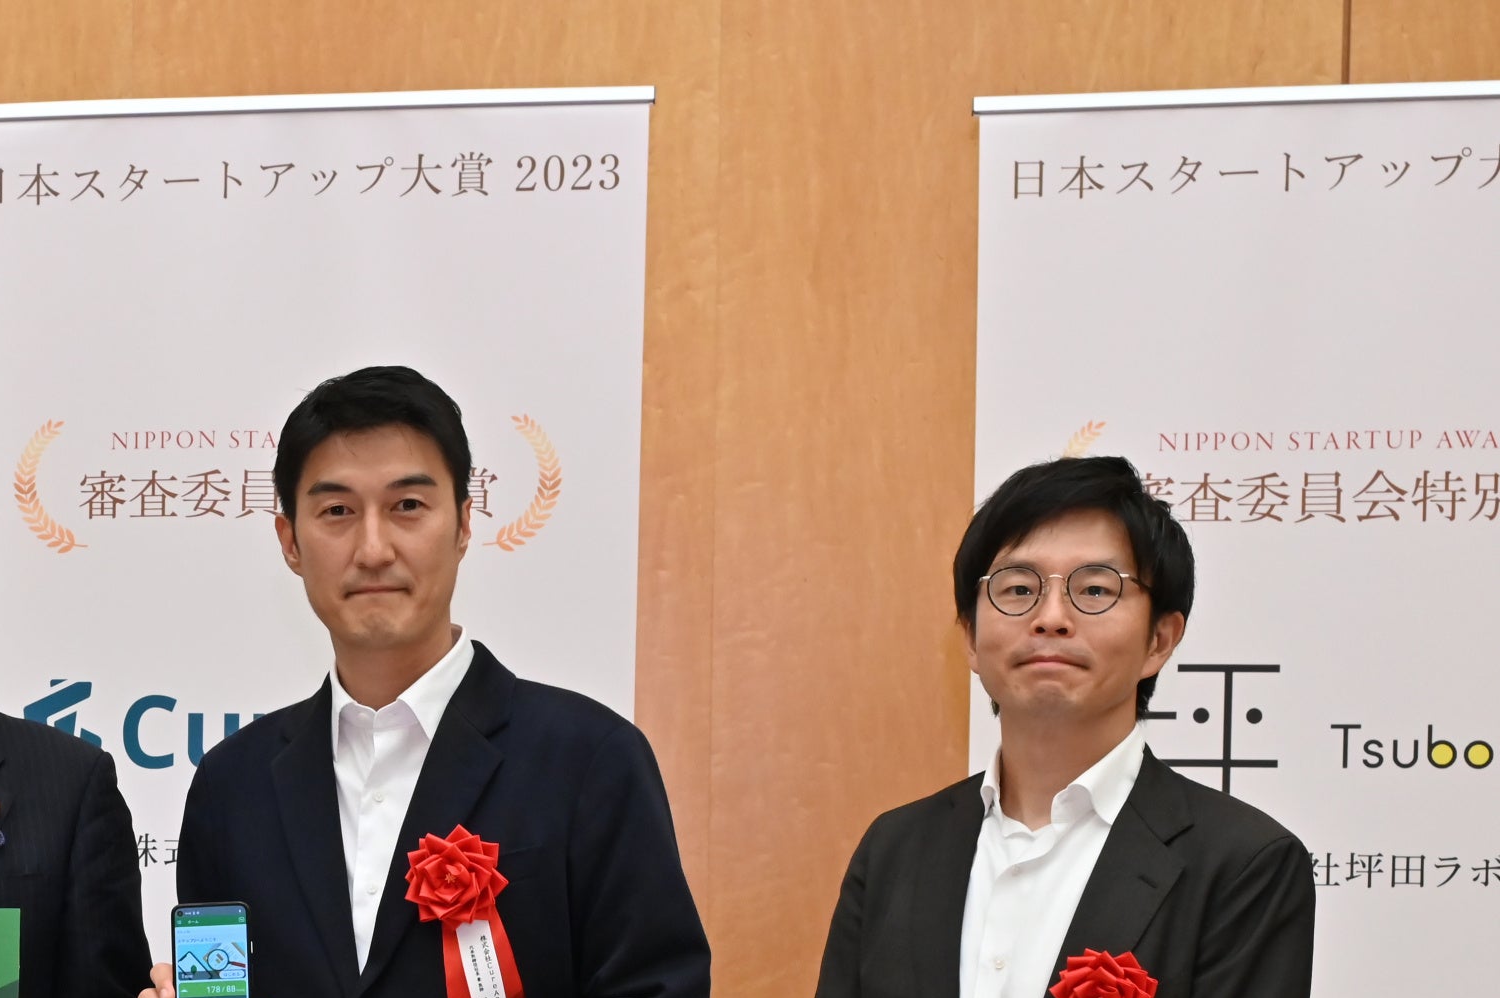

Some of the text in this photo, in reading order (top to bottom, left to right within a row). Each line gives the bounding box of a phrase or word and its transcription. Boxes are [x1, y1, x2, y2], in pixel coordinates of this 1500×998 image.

[516, 153, 622, 192] 2023
[110, 430, 276, 451] NIPPON STA
[1158, 432, 1274, 452] NIPPON
[1288, 431, 1423, 451] STARTUP
[1330, 723, 1494, 769] Tsubo
